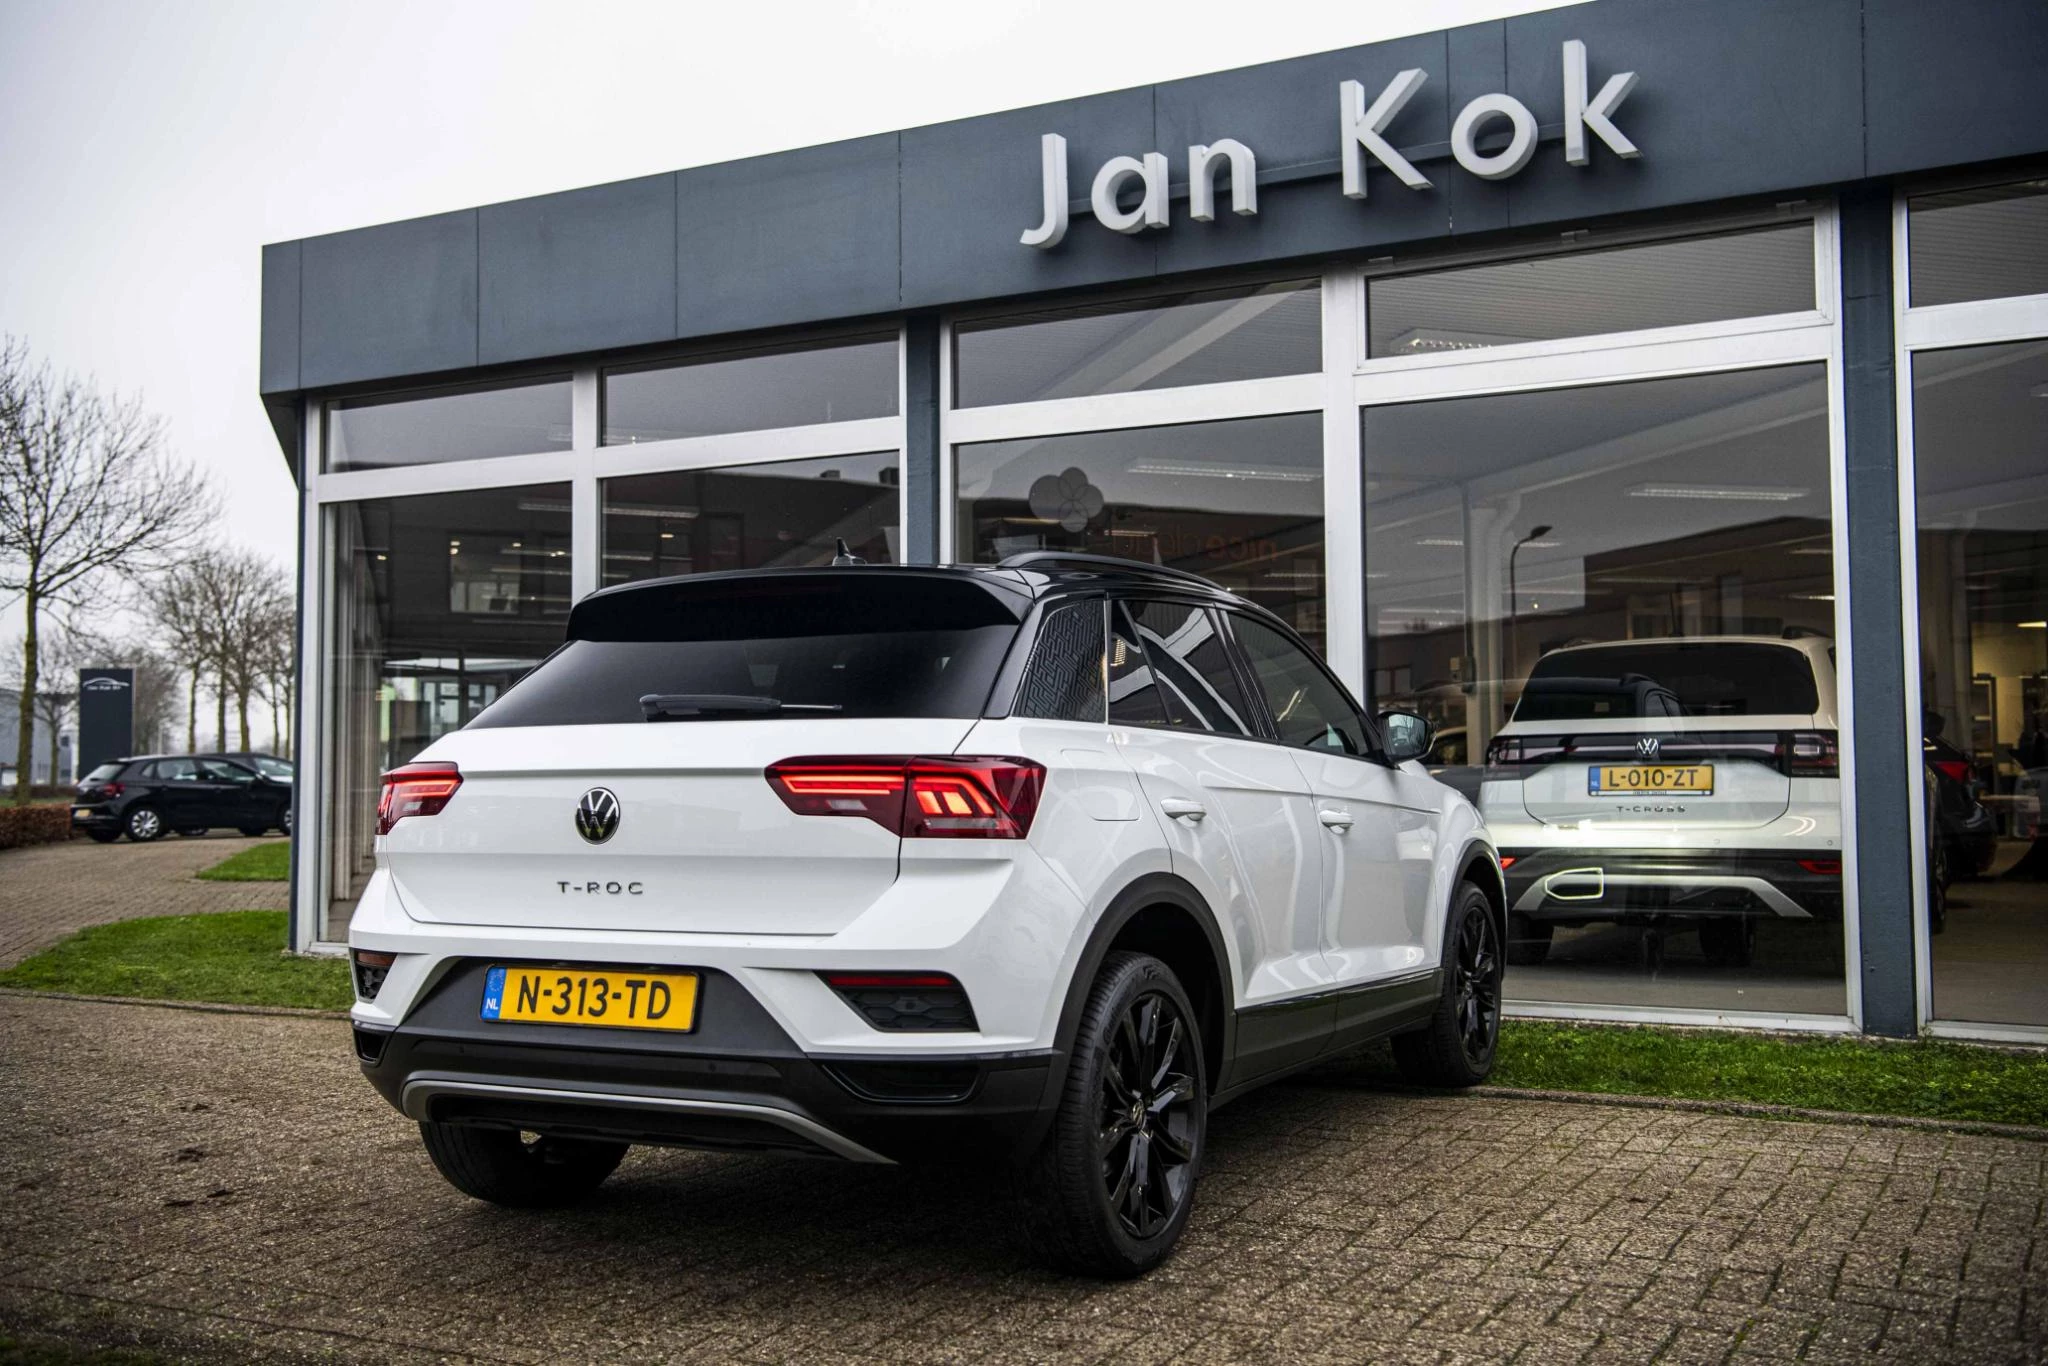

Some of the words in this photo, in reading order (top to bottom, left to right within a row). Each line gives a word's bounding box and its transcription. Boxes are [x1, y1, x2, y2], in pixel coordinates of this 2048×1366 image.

[1019, 132, 1258, 249] Jan
[1338, 38, 1643, 200] Kok
[1608, 768, 1699, 788] L-010-ZT
[557, 880, 645, 896] T-ROC
[485, 998, 499, 1011] NL
[517, 975, 672, 1021] N-313-TD
